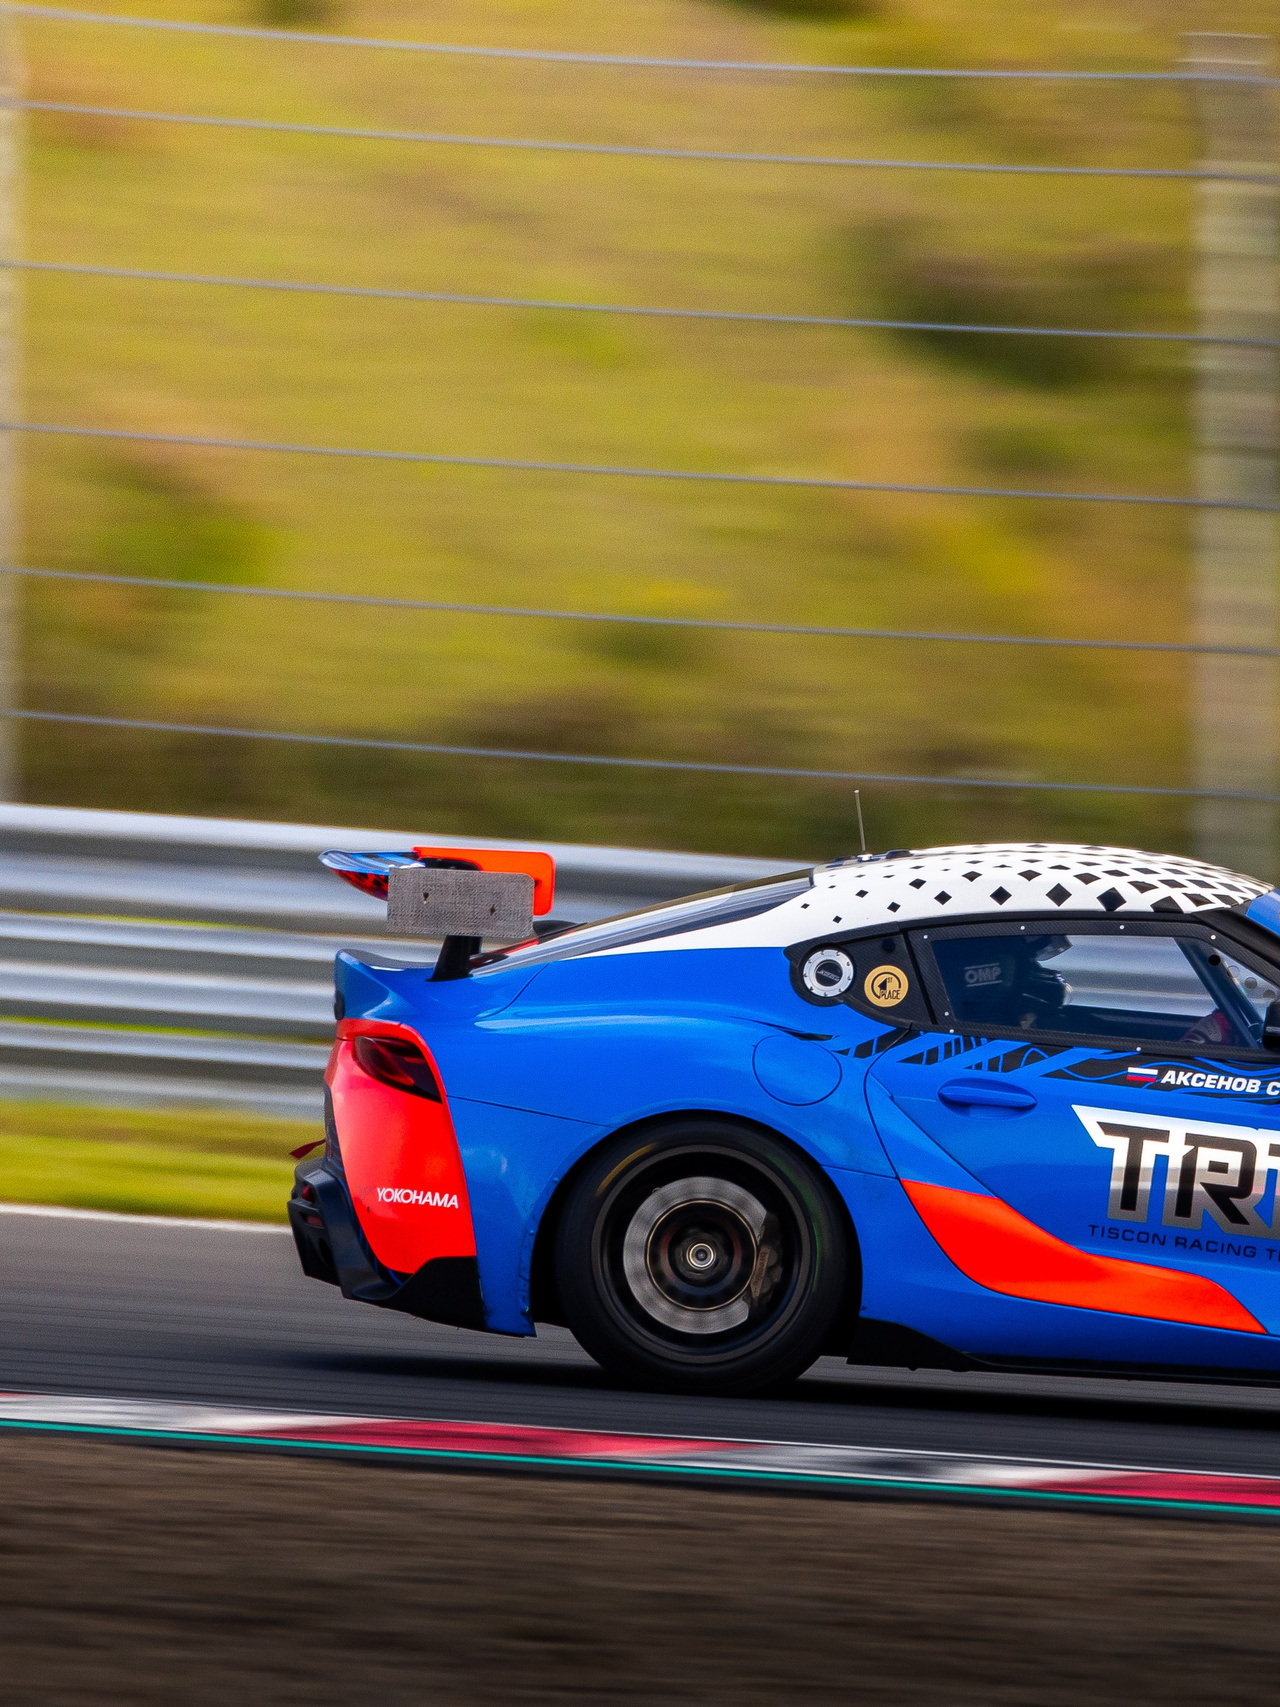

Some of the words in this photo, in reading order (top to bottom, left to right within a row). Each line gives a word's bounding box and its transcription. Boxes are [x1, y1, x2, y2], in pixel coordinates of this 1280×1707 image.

[965, 966, 1001, 984] OMP
[1161, 1070, 1262, 1093] АКСЕНОВ
[376, 1187, 459, 1209] YOKOHAMA
[1088, 1224, 1167, 1246] TISCON
[1174, 1236, 1257, 1258] RACING
